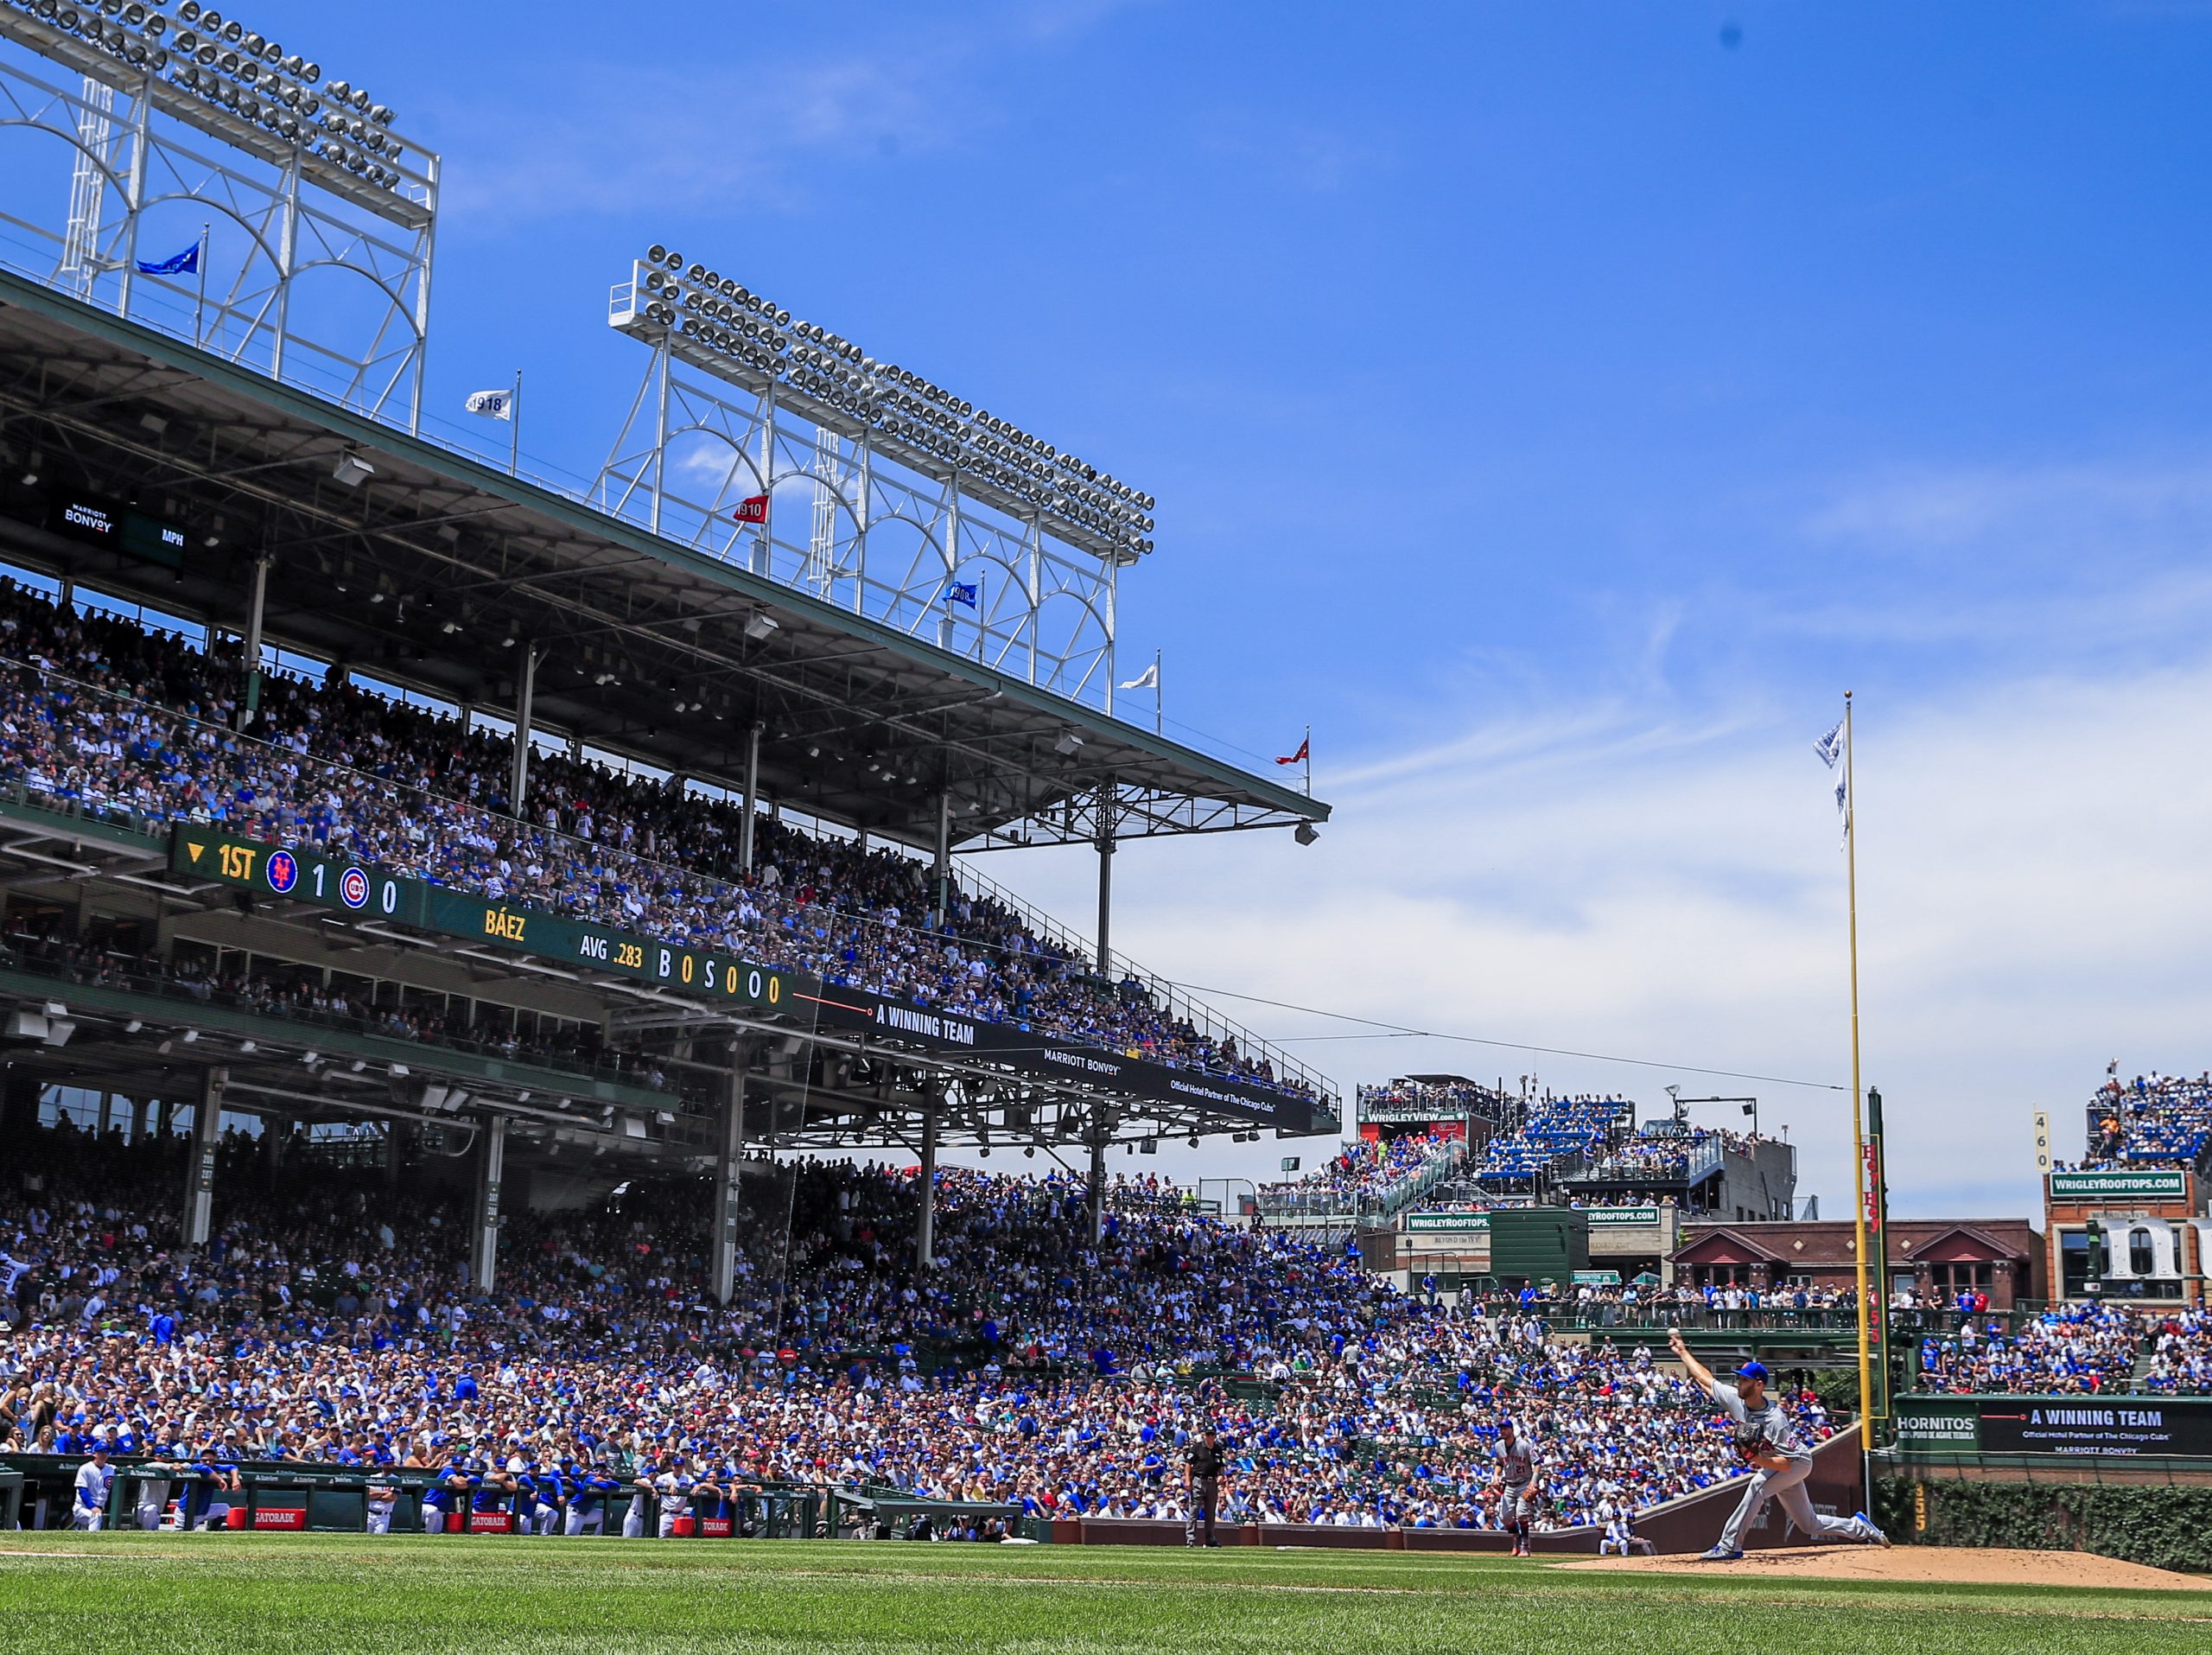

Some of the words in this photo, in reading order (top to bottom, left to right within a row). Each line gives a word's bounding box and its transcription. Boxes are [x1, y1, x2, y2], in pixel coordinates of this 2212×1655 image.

[472, 397, 502, 411] 1918
[65, 509, 111, 533] BONVOY
[73, 503, 106, 519] MARRIOTT
[737, 503, 762, 517] 1910
[162, 529, 184, 546] MPH
[219, 843, 256, 881] 1ST
[312, 863, 325, 897] 1
[383, 880, 397, 914] 0
[485, 906, 526, 942] BÁEZ
[580, 935, 607, 960] AVG
[613, 943, 643, 969] .283
[658, 949, 671, 977] B
[682, 955, 693, 983] 0
[704, 960, 715, 989] S
[727, 966, 737, 994] 0
[768, 976, 779, 1004] 0
[876, 1003, 886, 1025] A
[888, 1006, 940, 1037] WINNING
[943, 1019, 975, 1046] TEAM
[1044, 1048, 1085, 1069] MARRIOTT
[1087, 1059, 1120, 1076] BONVOY
[1170, 1079, 1189, 1092] Official
[1189, 1084, 1205, 1097] Hotel
[1205, 1088, 1223, 1101] Partner
[1224, 1093, 1230, 1102] of
[1230, 1094, 1240, 1105] The
[1240, 1096, 1261, 1111] Chicago
[1261, 1102, 1274, 1113] Cubs
[2036, 1117, 2047, 1166] 460
[1861, 1144, 1880, 1187] Hey
[2055, 1178, 2179, 1190] WRIGLEYROOFTOPS.COM
[1863, 1191, 1880, 1233] Hey
[1897, 1416, 1974, 1430] HORNITOS
[2031, 1410, 2042, 1425] A
[2045, 1410, 2114, 1426] WINNING
[2117, 1410, 2162, 1427] TEAM
[2119, 1432, 2149, 1442] Chicago
[1516, 1465, 1525, 1474] 21
[471, 1517, 505, 1526] GATORADE
[1915, 1483, 1925, 1531] 355
